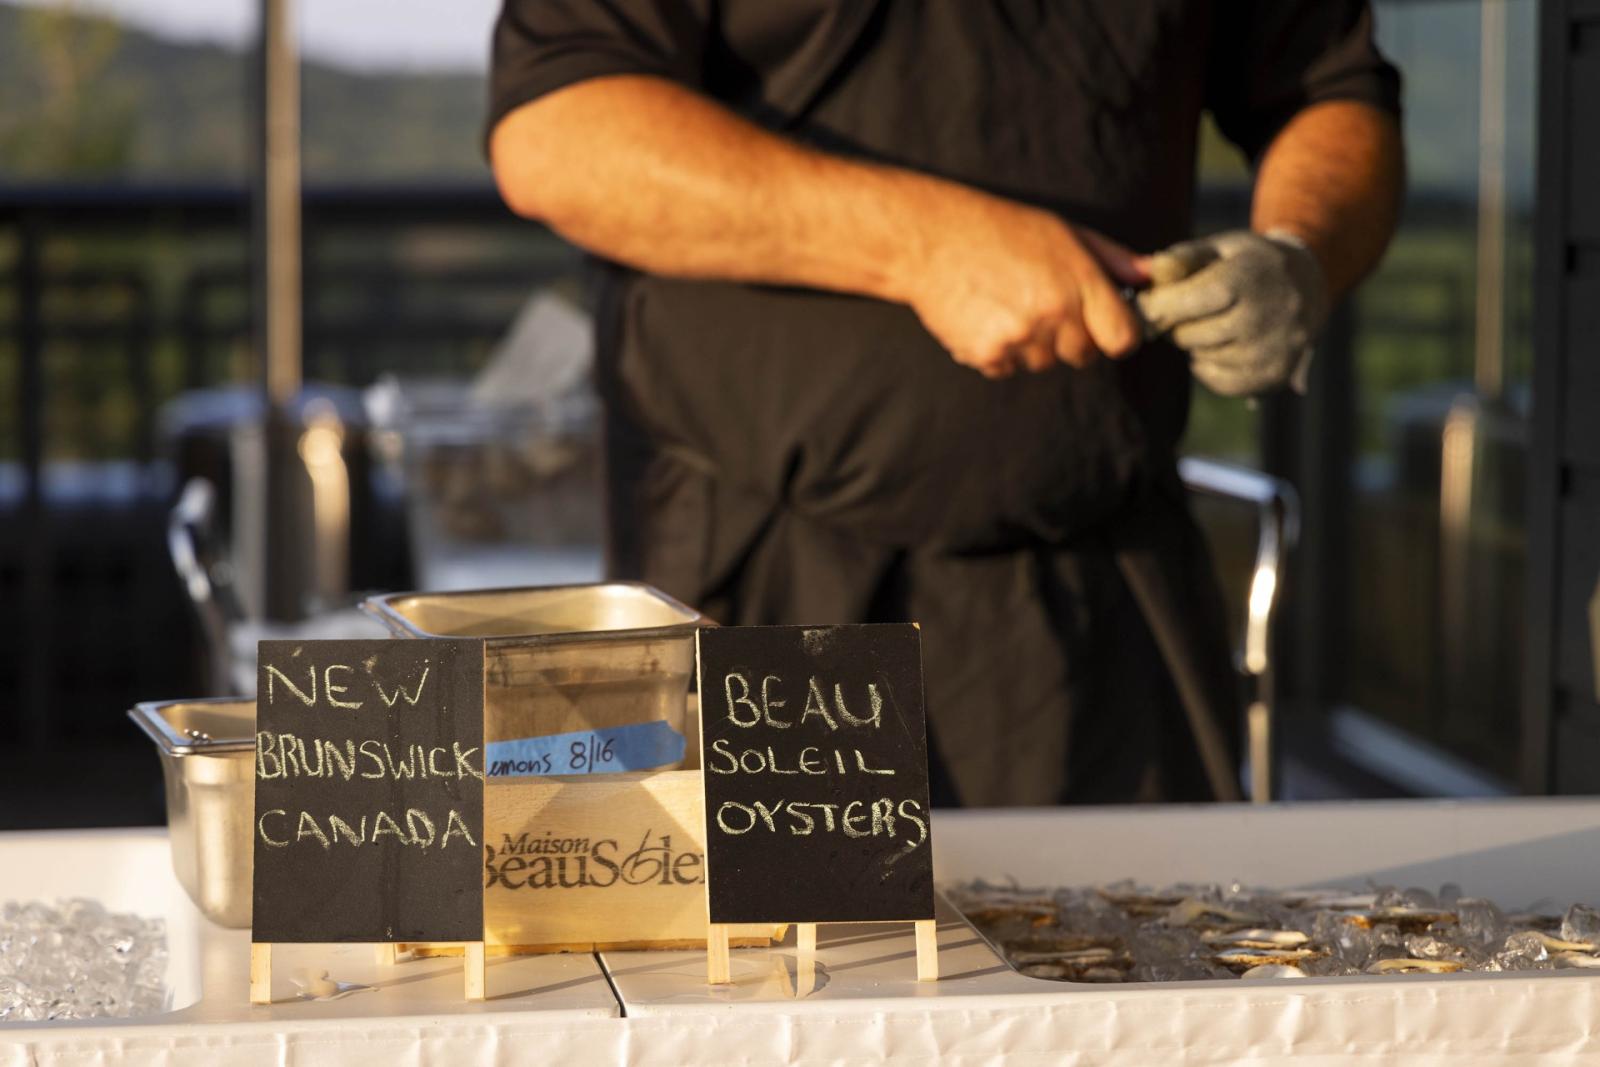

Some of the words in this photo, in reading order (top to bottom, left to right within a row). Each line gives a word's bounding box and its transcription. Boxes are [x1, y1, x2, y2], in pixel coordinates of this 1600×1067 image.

[263, 663, 430, 709] NEW
[725, 672, 883, 731] BEAU
[256, 731, 484, 781] BRUNSWICK
[486, 752, 552, 777] emons
[569, 735, 616, 773] 8/16
[708, 739, 896, 775] SOLEIL
[258, 808, 477, 849] CANADA
[497, 831, 591, 856] Maison
[716, 797, 928, 848] OYSTERS
